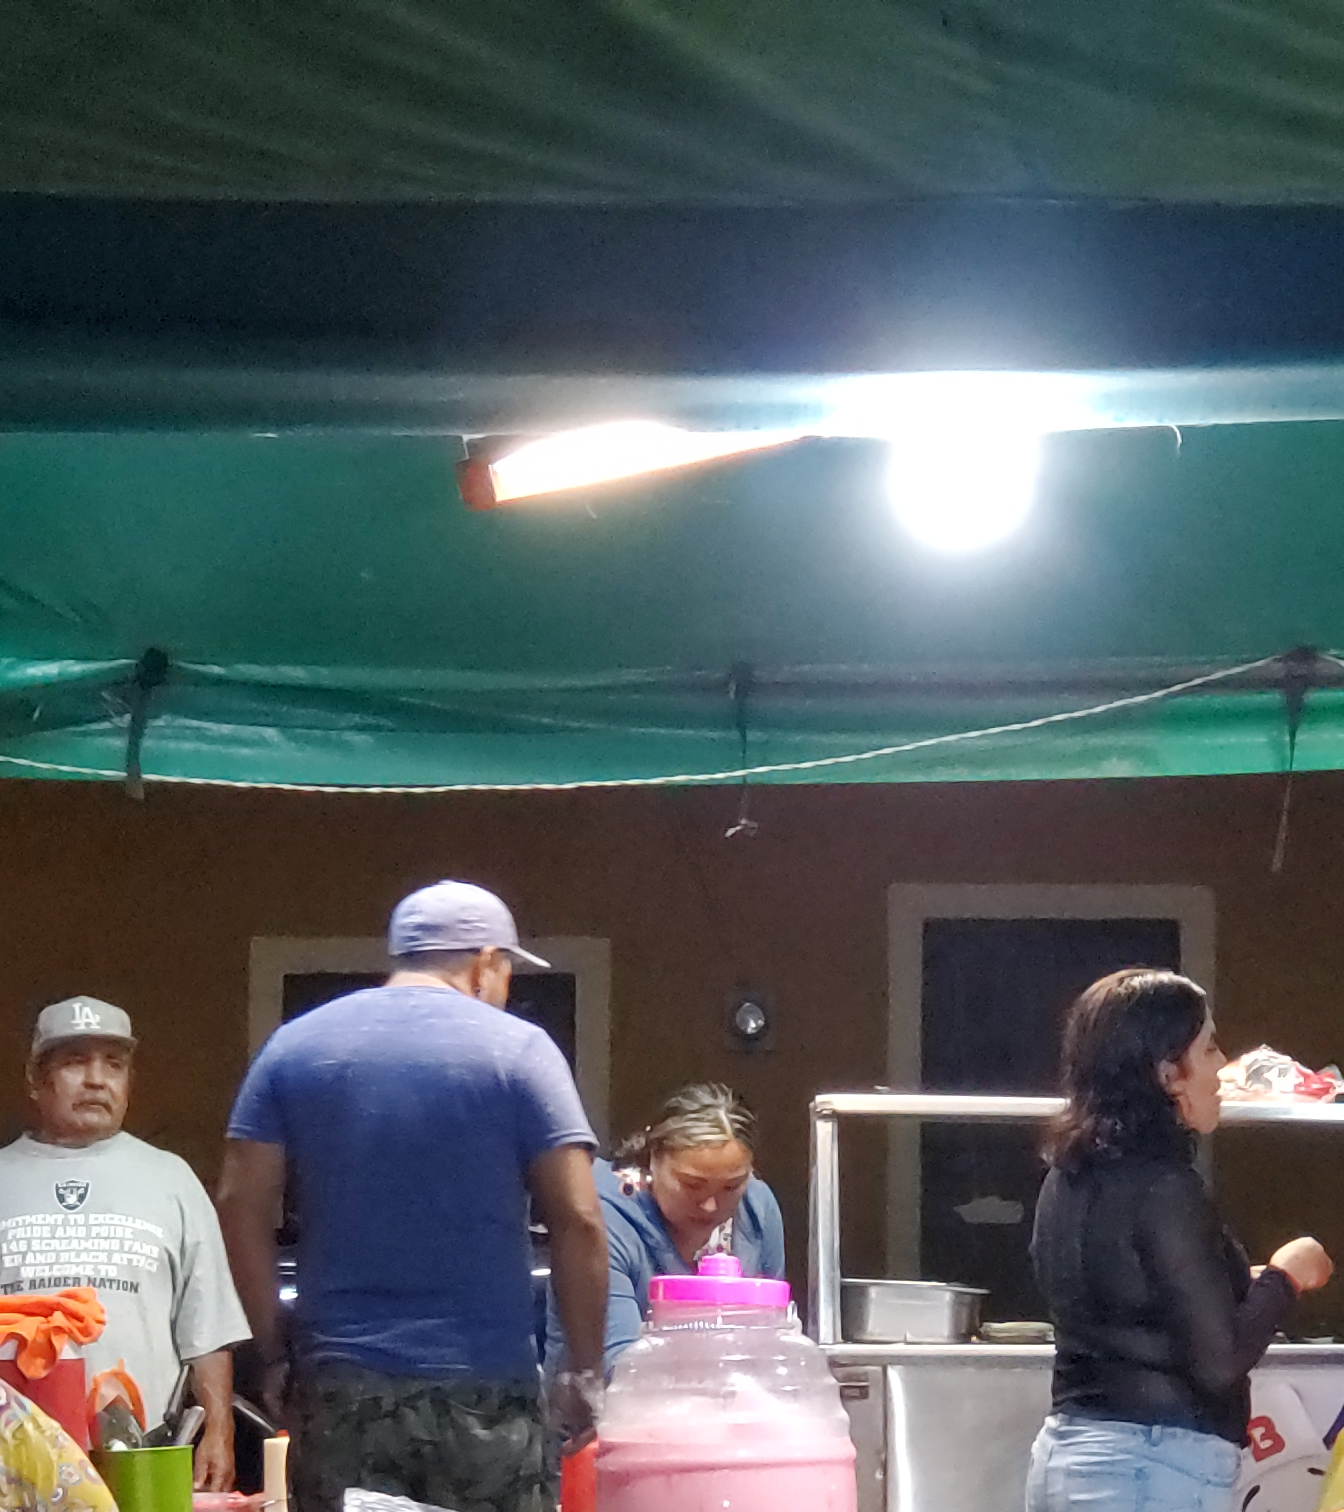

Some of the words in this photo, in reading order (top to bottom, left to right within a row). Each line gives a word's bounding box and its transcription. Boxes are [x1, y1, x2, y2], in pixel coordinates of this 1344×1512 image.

[70, 1002, 101, 1029] LA
[7, 1226, 51, 1240] PRIDE
[54, 1225, 86, 1239] AND
[90, 1226, 134, 1240] POISE
[67, 1213, 85, 1226] TO
[88, 1213, 164, 1239] EXCELLENCE
[31, 1239, 120, 1253] SCREAMING
[123, 1241, 160, 1259] FANS
[24, 1252, 56, 1265] AND
[59, 1252, 108, 1264] BLACK
[20, 1264, 94, 1278] WELCOME
[97, 1264, 118, 1277] TO
[28, 1276, 83, 1291] RAIDER
[87, 1277, 140, 1294] NATION
